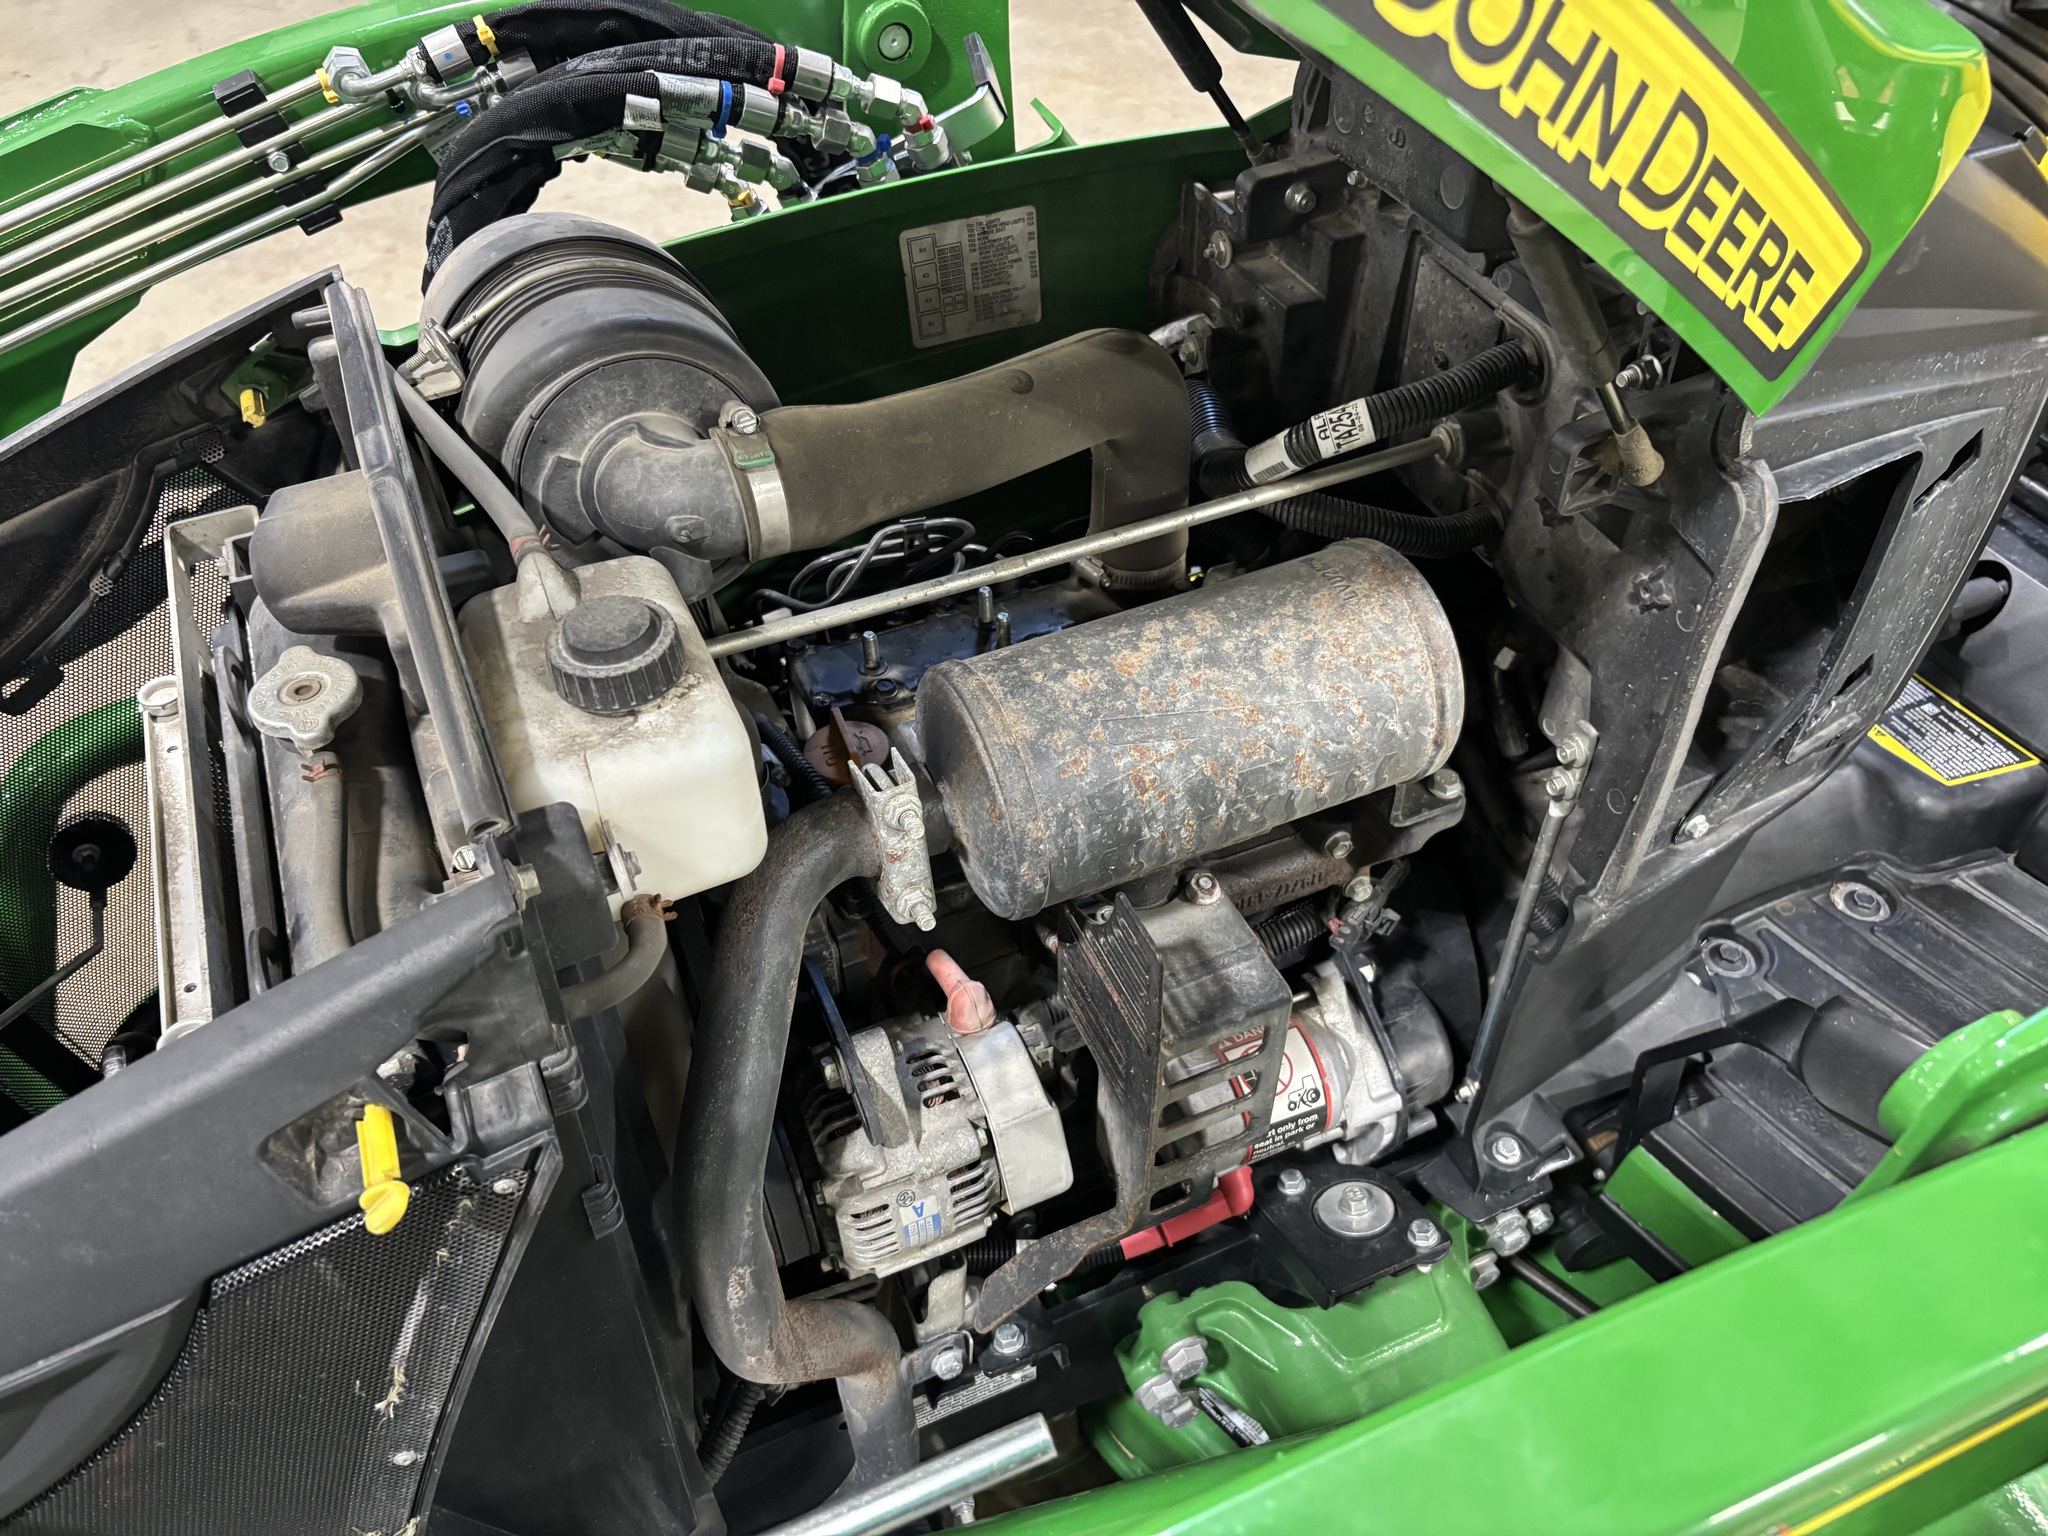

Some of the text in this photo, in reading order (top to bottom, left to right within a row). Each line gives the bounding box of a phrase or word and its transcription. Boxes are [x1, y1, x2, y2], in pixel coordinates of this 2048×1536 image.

[1397, 0, 1814, 340] OHN DEERE
[1233, 1024, 1265, 1042] DAN
[1254, 1121, 1315, 1149] seat in park or
[1277, 1118, 1297, 1133] only
[1297, 1113, 1318, 1127] from
